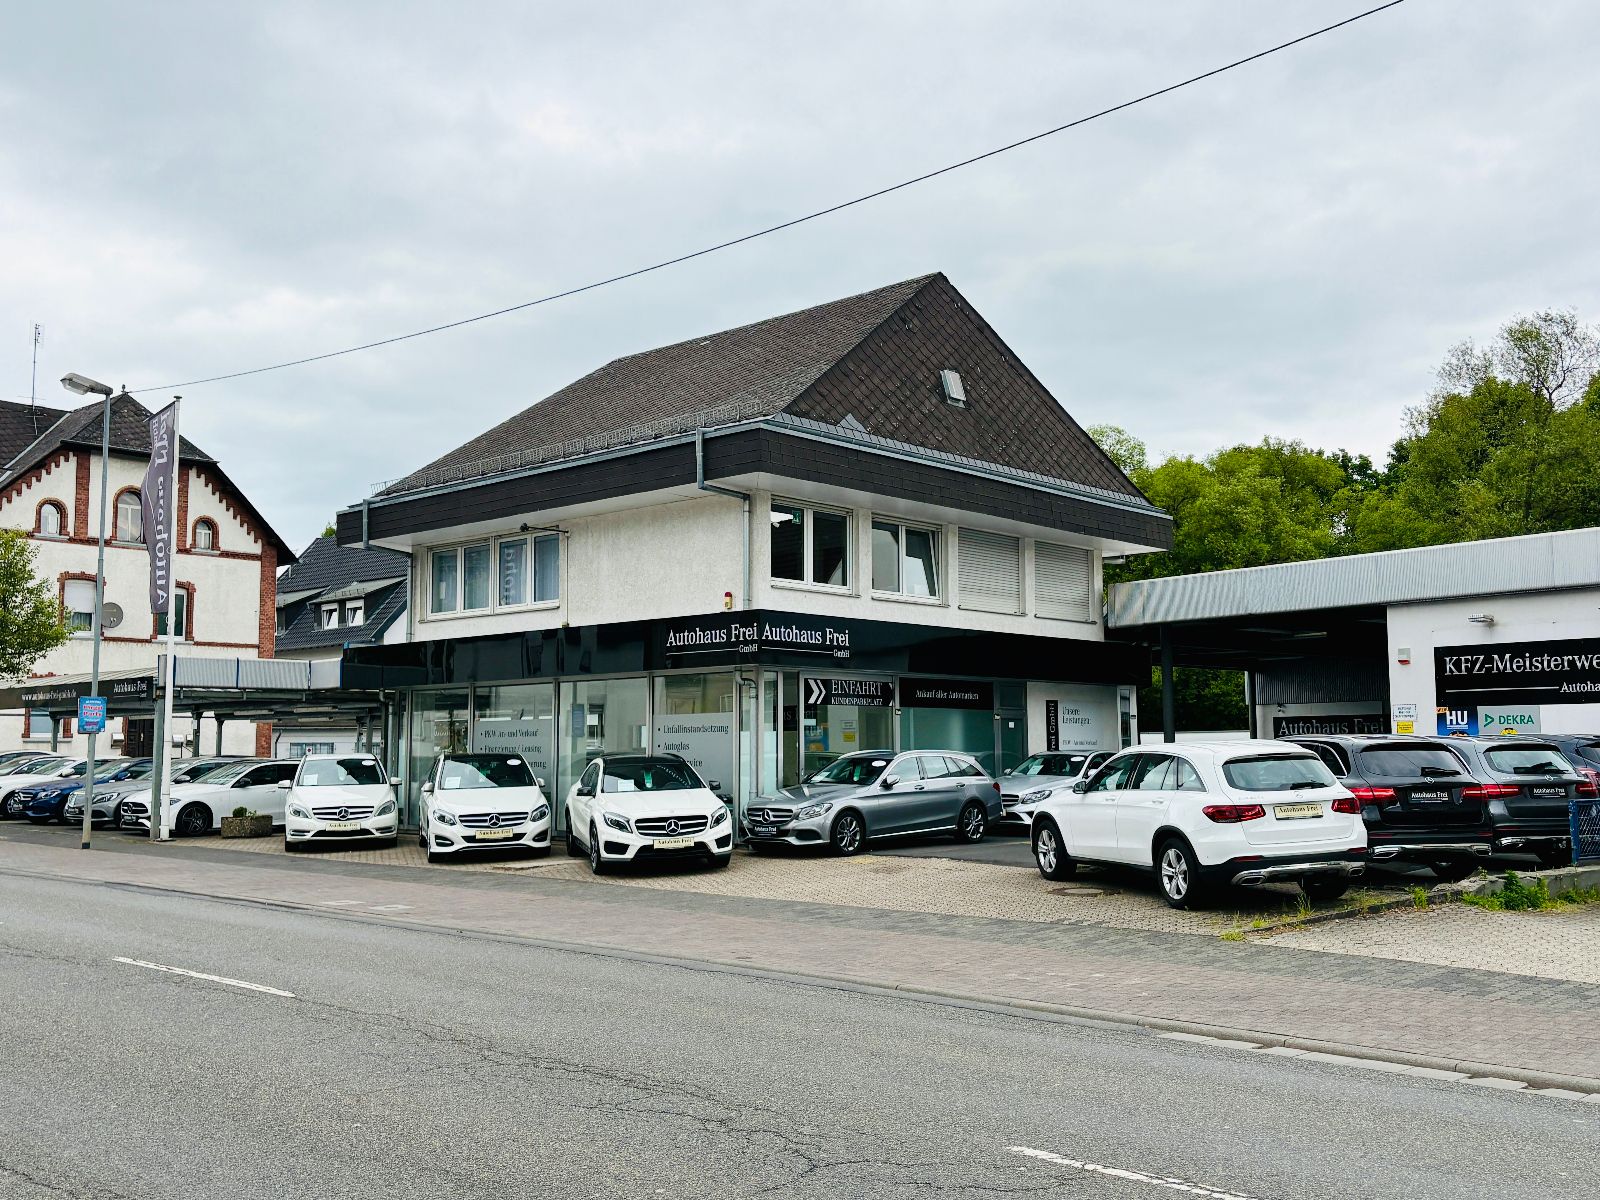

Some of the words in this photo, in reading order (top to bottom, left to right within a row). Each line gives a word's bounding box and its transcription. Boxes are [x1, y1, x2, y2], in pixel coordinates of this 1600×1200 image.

[666, 627, 727, 647] Autohaus
[730, 622, 759, 642] Frei
[761, 622, 823, 644] Autohaus
[825, 628, 850, 647] Frei
[739, 643, 758, 653] GmbH
[833, 649, 850, 658] GmbH
[1443, 652, 1600, 676] KFZ-Meisterwe
[113, 681, 137, 693] Autohaus
[831, 679, 883, 696] EINFAHRT
[915, 689, 935, 698] Ankauf
[936, 689, 948, 699] aller
[831, 696, 883, 706] KUNDENPARKPLATZ
[1446, 710, 1468, 726] HU
[1498, 715, 1535, 725] DEKRA
[663, 724, 729, 735] Unfallinstandsetzung
[1277, 719, 1349, 736] Autohaus
[1353, 718, 1385, 734] Frei
[662, 741, 690, 752] Autoglas
